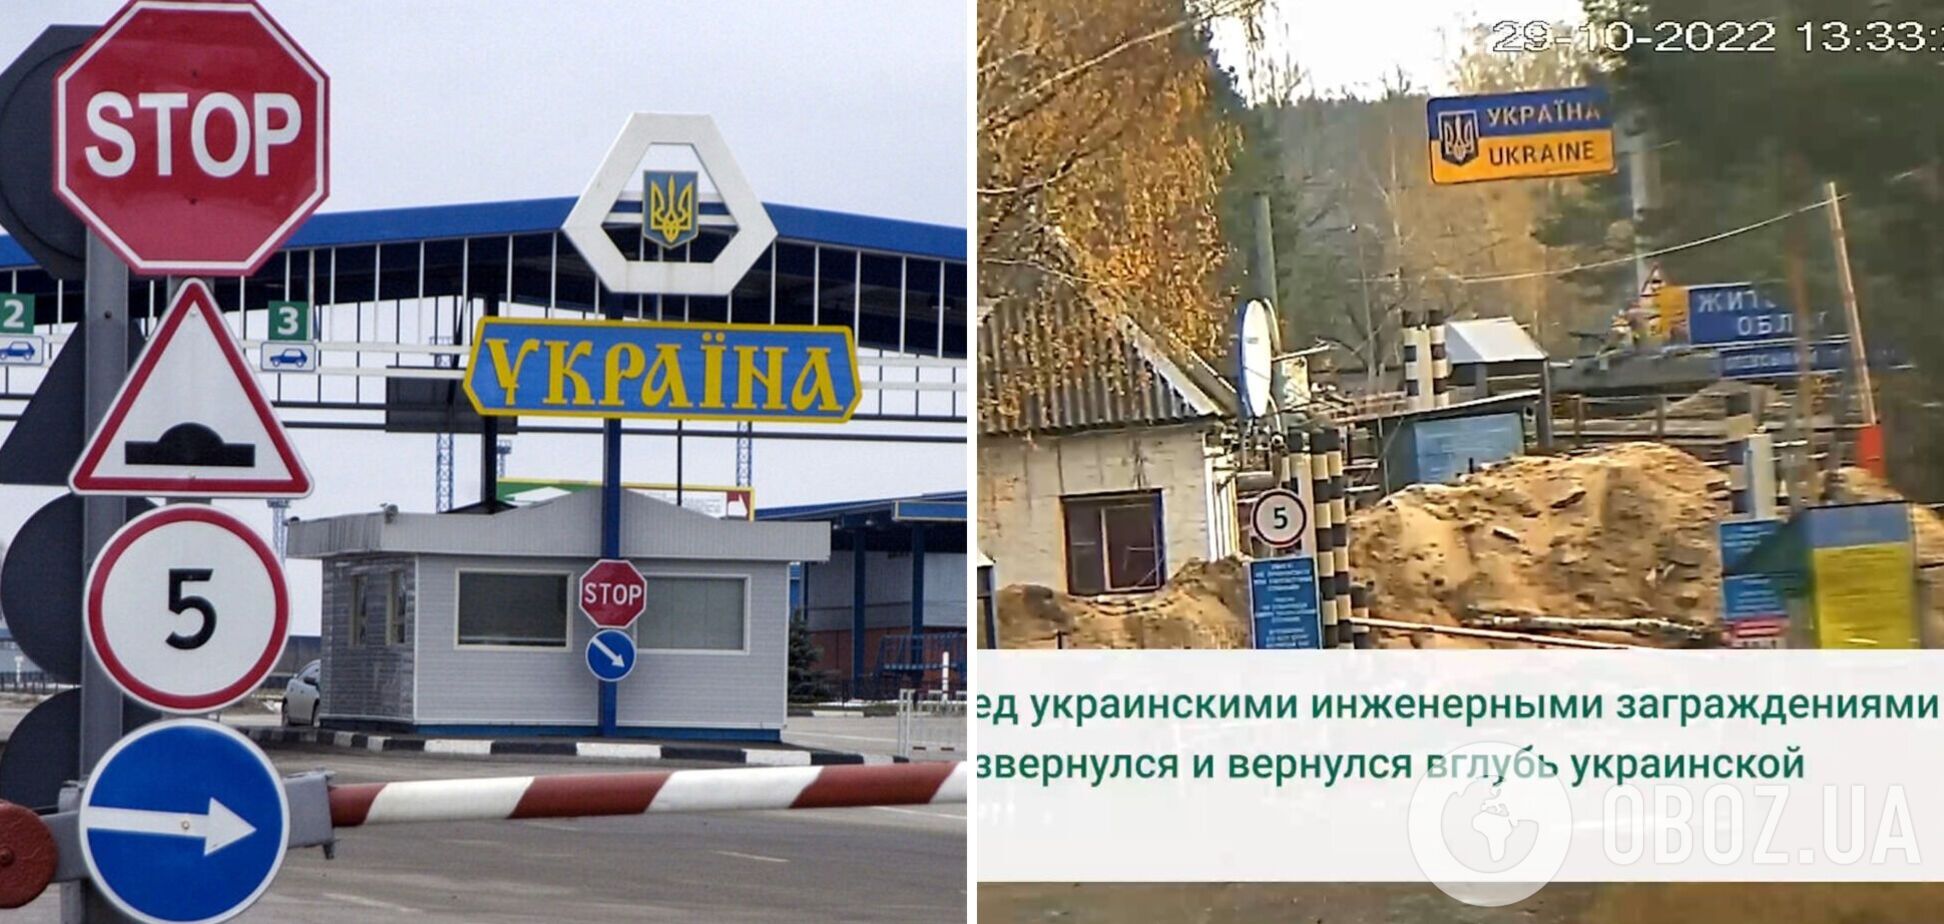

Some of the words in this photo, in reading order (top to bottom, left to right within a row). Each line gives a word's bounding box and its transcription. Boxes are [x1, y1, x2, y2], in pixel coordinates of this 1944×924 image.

[1486, 99, 1601, 128] УКРАЇНА
[84, 91, 303, 179] STOP
[1489, 140, 1595, 166] UKRAINE
[2, 298, 25, 329] 2
[276, 305, 300, 336] 3
[485, 331, 844, 412] УКРАЇНА
[1273, 506, 1288, 530] 5
[584, 580, 643, 606] STOP
[164, 567, 217, 651] 5
